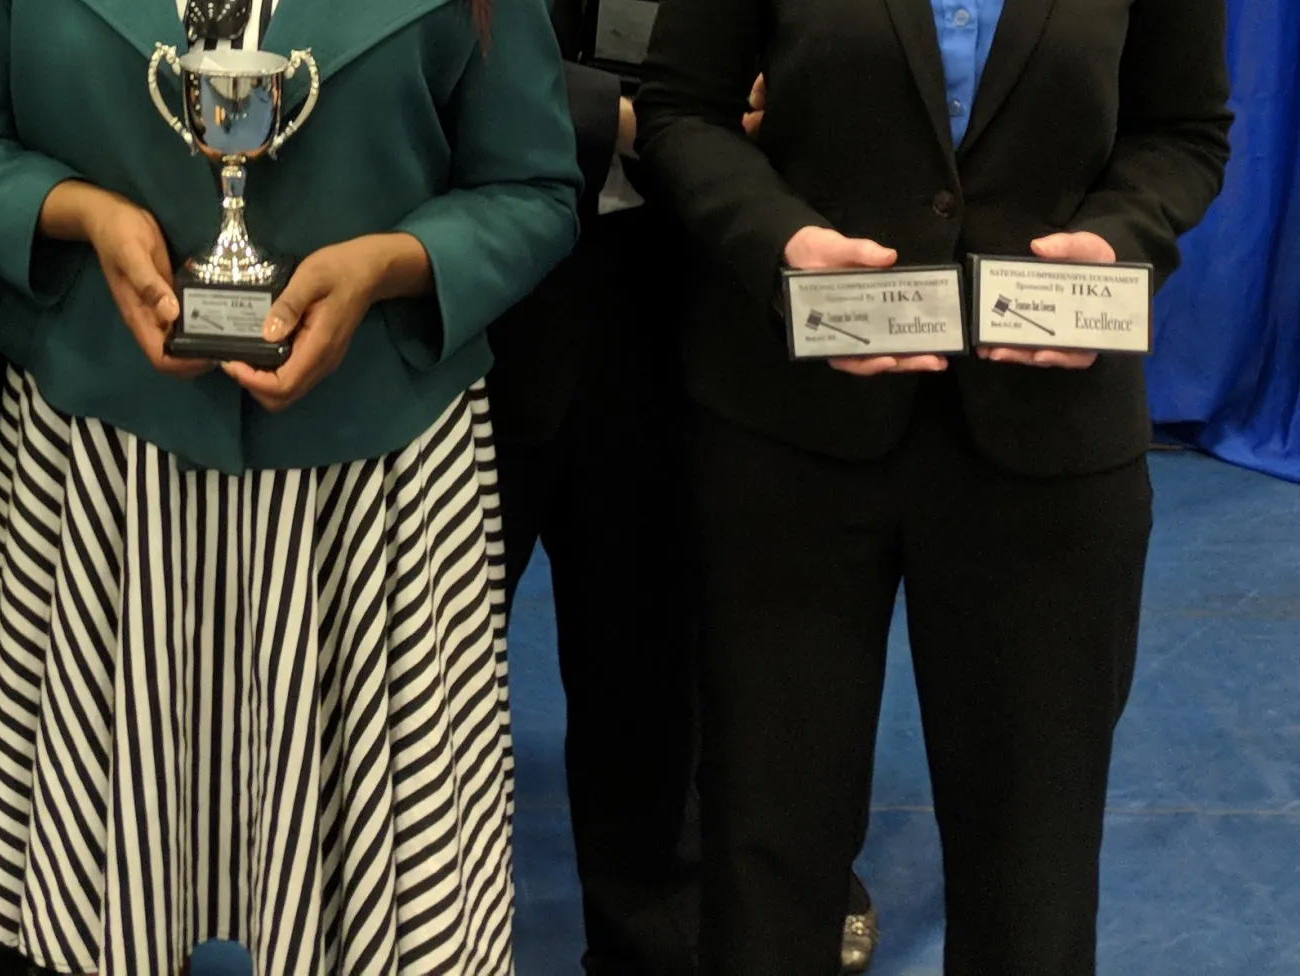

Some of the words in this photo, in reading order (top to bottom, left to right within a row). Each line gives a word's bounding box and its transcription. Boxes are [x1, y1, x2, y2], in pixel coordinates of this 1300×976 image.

[990, 269, 1026, 278] NATIONAL
[1089, 274, 1139, 284] TOURNAMENT
[882, 290, 924, 303] ΠΚΔ
[1071, 284, 1112, 298] ΠΚΔ
[887, 316, 947, 336] Excellence
[1075, 311, 1133, 332] Excellence
